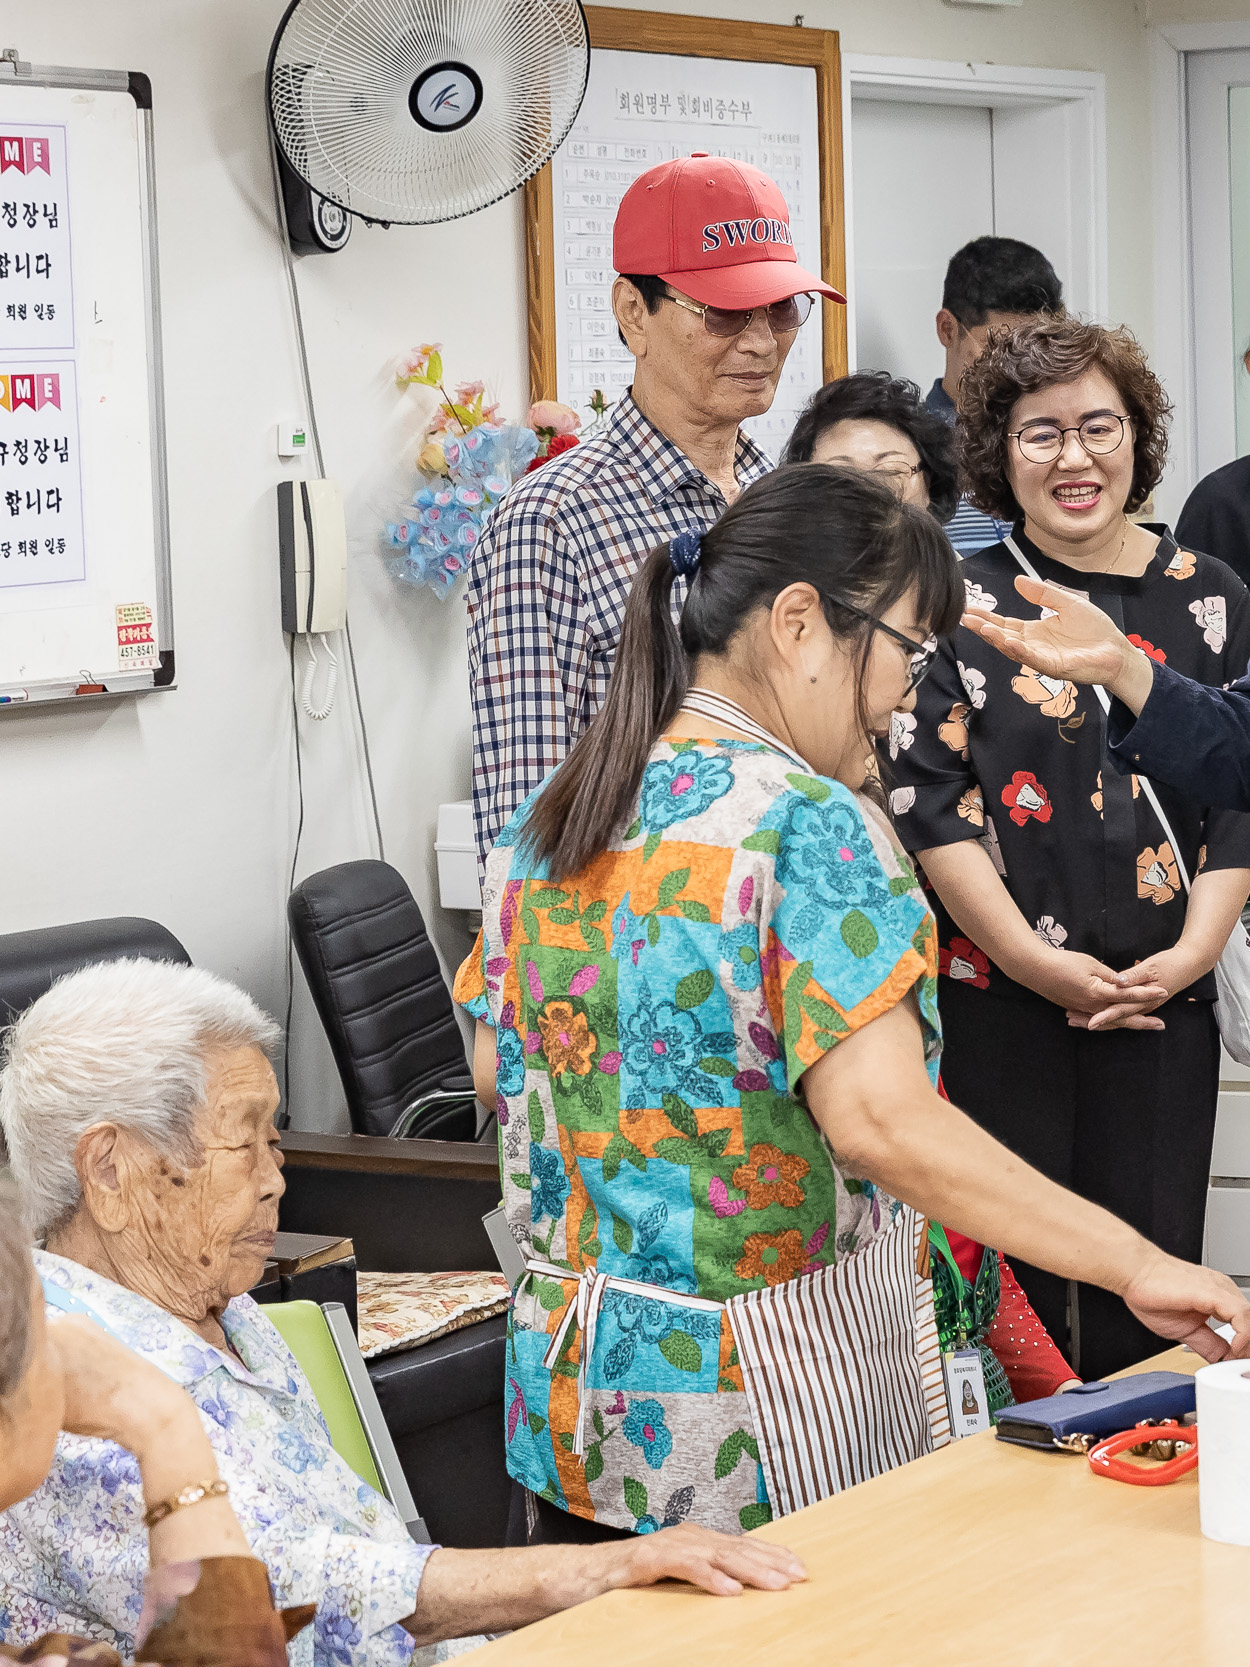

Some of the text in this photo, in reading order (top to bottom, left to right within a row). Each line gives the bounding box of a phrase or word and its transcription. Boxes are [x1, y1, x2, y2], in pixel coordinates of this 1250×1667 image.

[619, 91, 671, 115] 회원명부
[2, 201, 58, 229] 청장님
[6, 303, 55, 321] 회원 일동
[5, 487, 62, 517] 합니다
[18, 539, 38, 557] 회원
[44, 537, 66, 555] 일동
